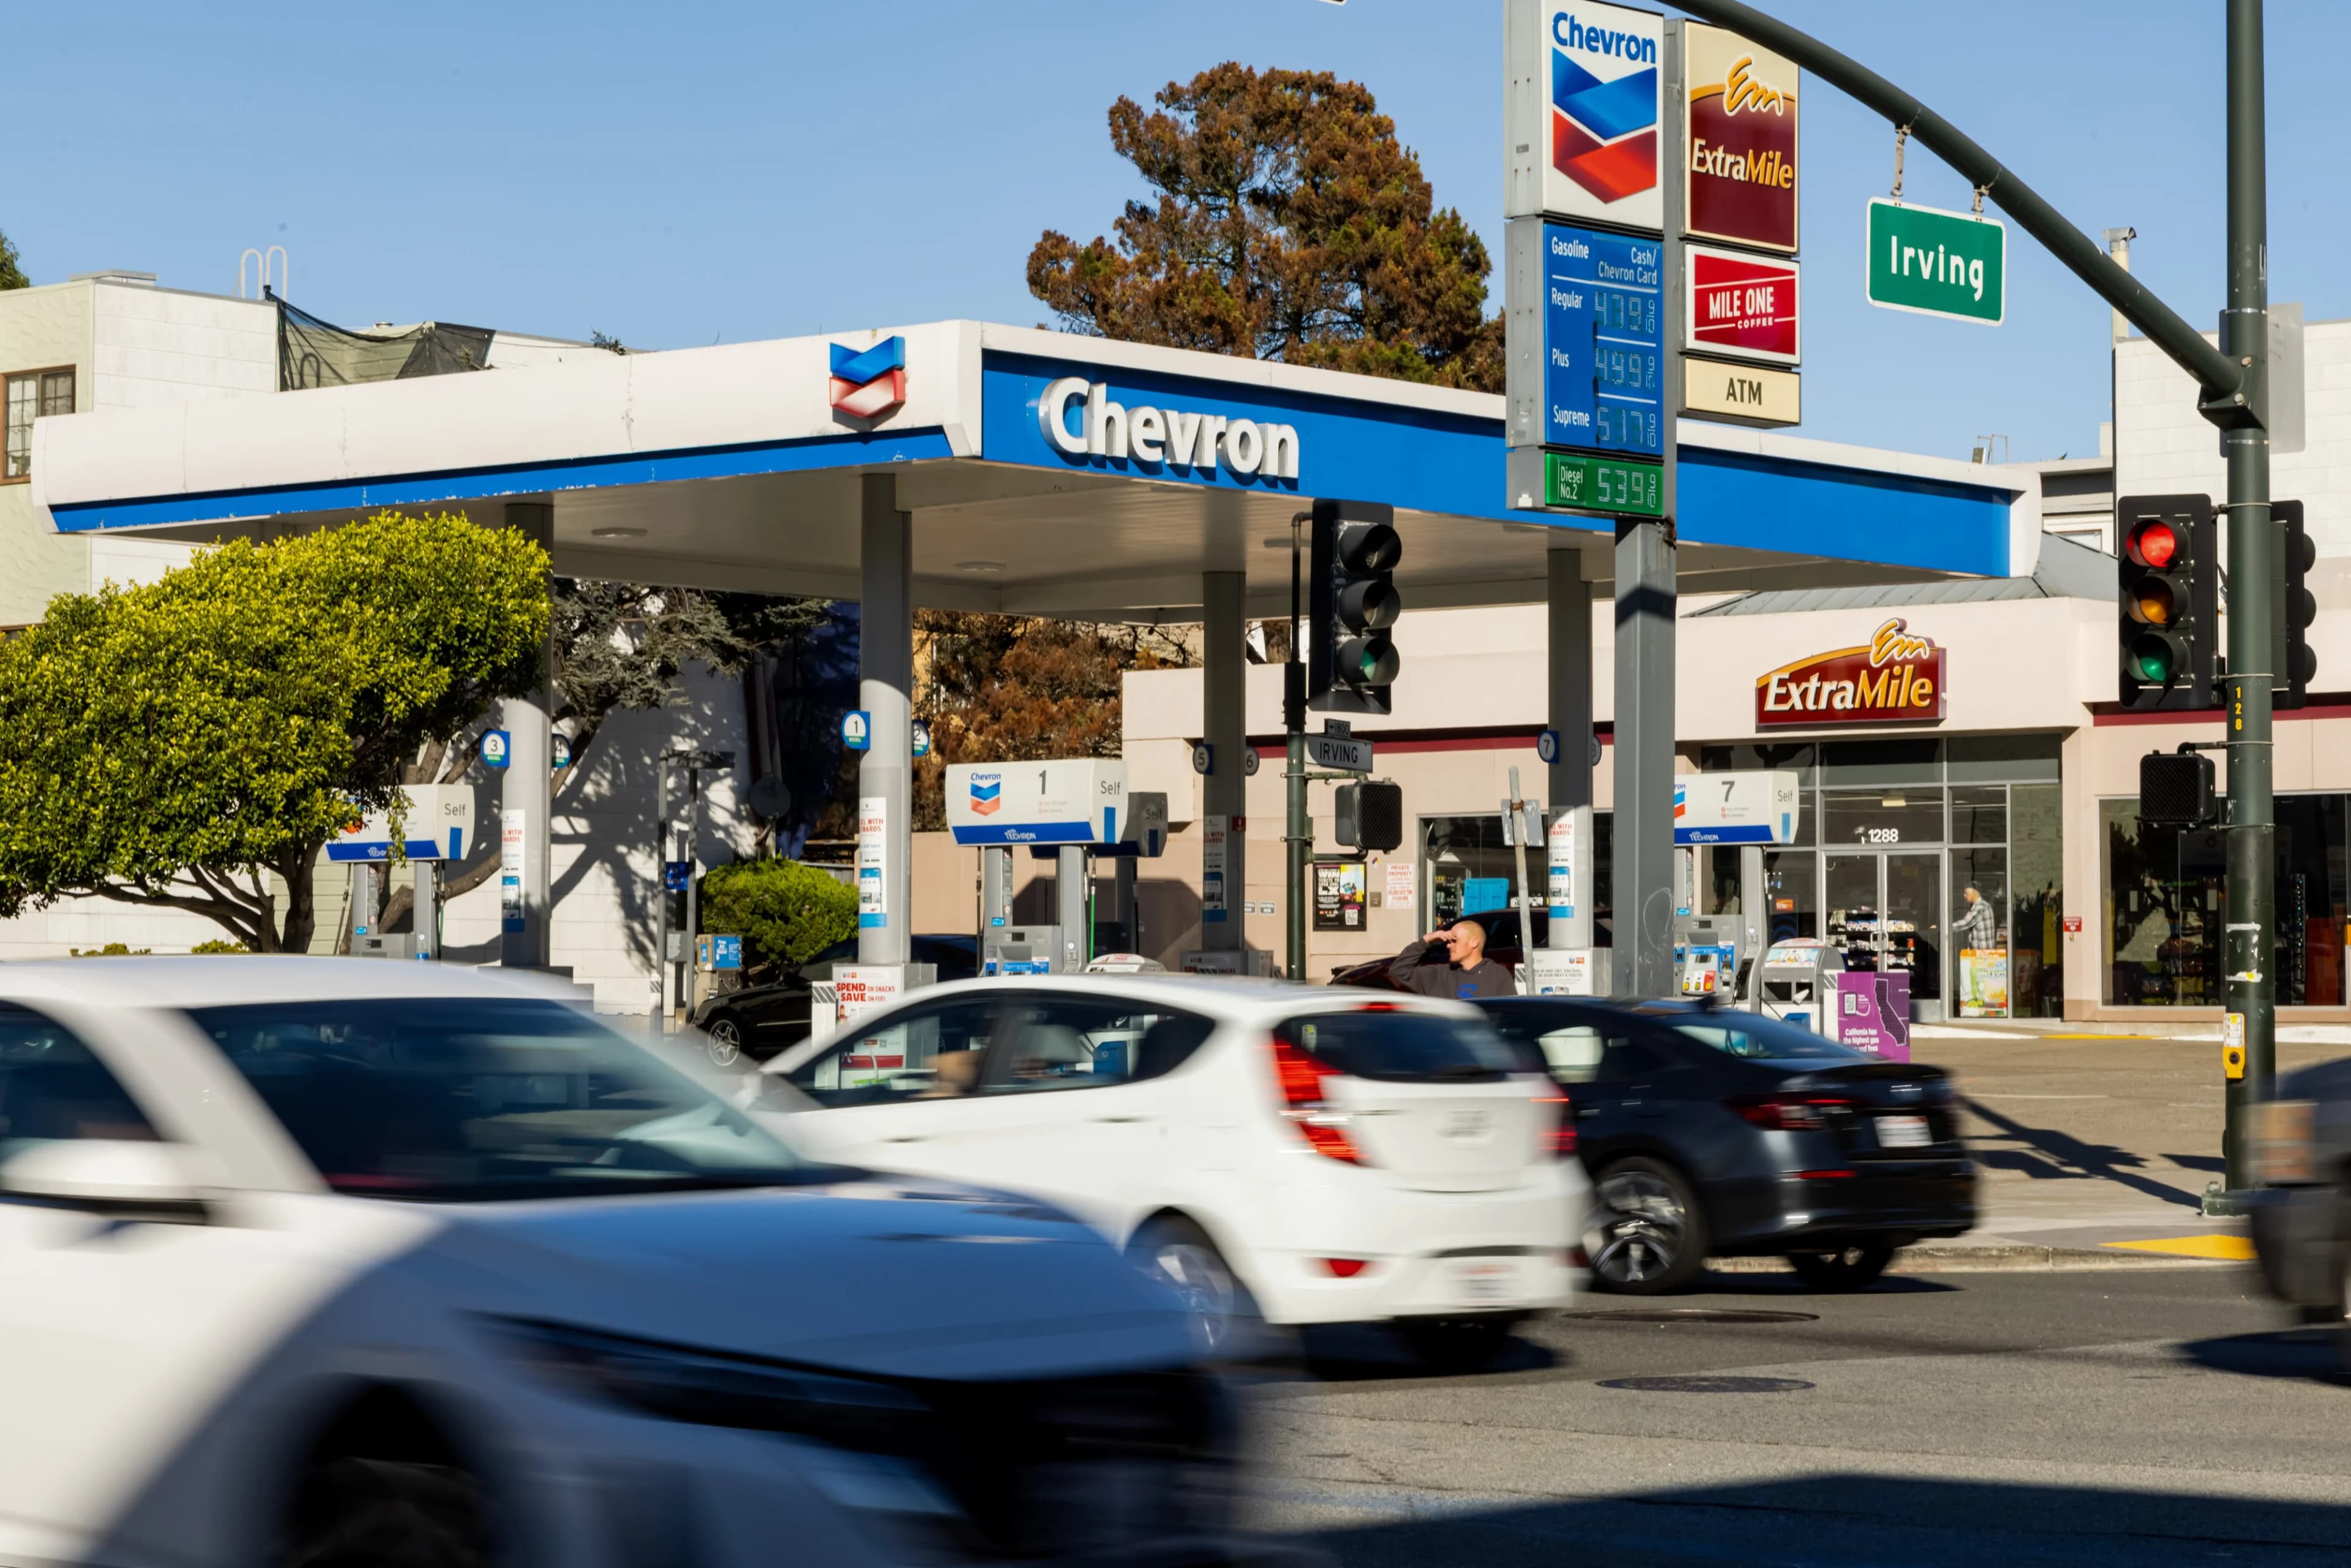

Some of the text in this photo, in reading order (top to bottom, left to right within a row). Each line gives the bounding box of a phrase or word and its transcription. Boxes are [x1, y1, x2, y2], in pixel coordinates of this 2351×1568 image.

[1552, 12, 1657, 64] Chevron
[1691, 138, 1793, 189] ExtraMile
[1551, 236, 1589, 259] Gasoline
[1631, 247, 1657, 268] Cash/
[1599, 261, 1657, 285] Chevron Card
[1891, 234, 1984, 302] Irving
[1551, 287, 1583, 310] Regular
[1595, 291, 1641, 331] 479
[1709, 287, 1774, 320] MILE ONE
[1738, 317, 1773, 329] COFFEE
[1552, 348, 1570, 367] Plus
[1726, 377, 1762, 406] ATM
[1553, 405, 1590, 427] Supreme
[1038, 377, 1299, 479] Chevron
[1561, 465, 1583, 484] Diesel
[1599, 468, 1644, 505] 539
[1561, 482, 1578, 500] No.2
[1764, 664, 1933, 712] ExtraMile
[853, 719, 858, 734] 1
[913, 729, 921, 741] 2
[490, 739, 498, 752] 3
[556, 741, 563, 754] 4
[1319, 741, 1359, 764] IRVING
[1543, 740, 1550, 754] 7
[1198, 752, 1205, 765] 5
[1246, 754, 1254, 768] 6
[970, 773, 1001, 781] Chevron
[1039, 770, 1047, 795] 1
[1101, 780, 1121, 796] Self
[1721, 781, 1735, 803] 7
[1778, 790, 1793, 802] Self
[444, 803, 466, 816] Self
[1146, 808, 1162, 820] Self
[1004, 832, 1037, 841] TECHRON
[1868, 828, 1899, 842] 1288
[836, 983, 866, 992] SPEND
[841, 993, 866, 1002] SAVE
[1852, 1037, 1870, 1045] highest
